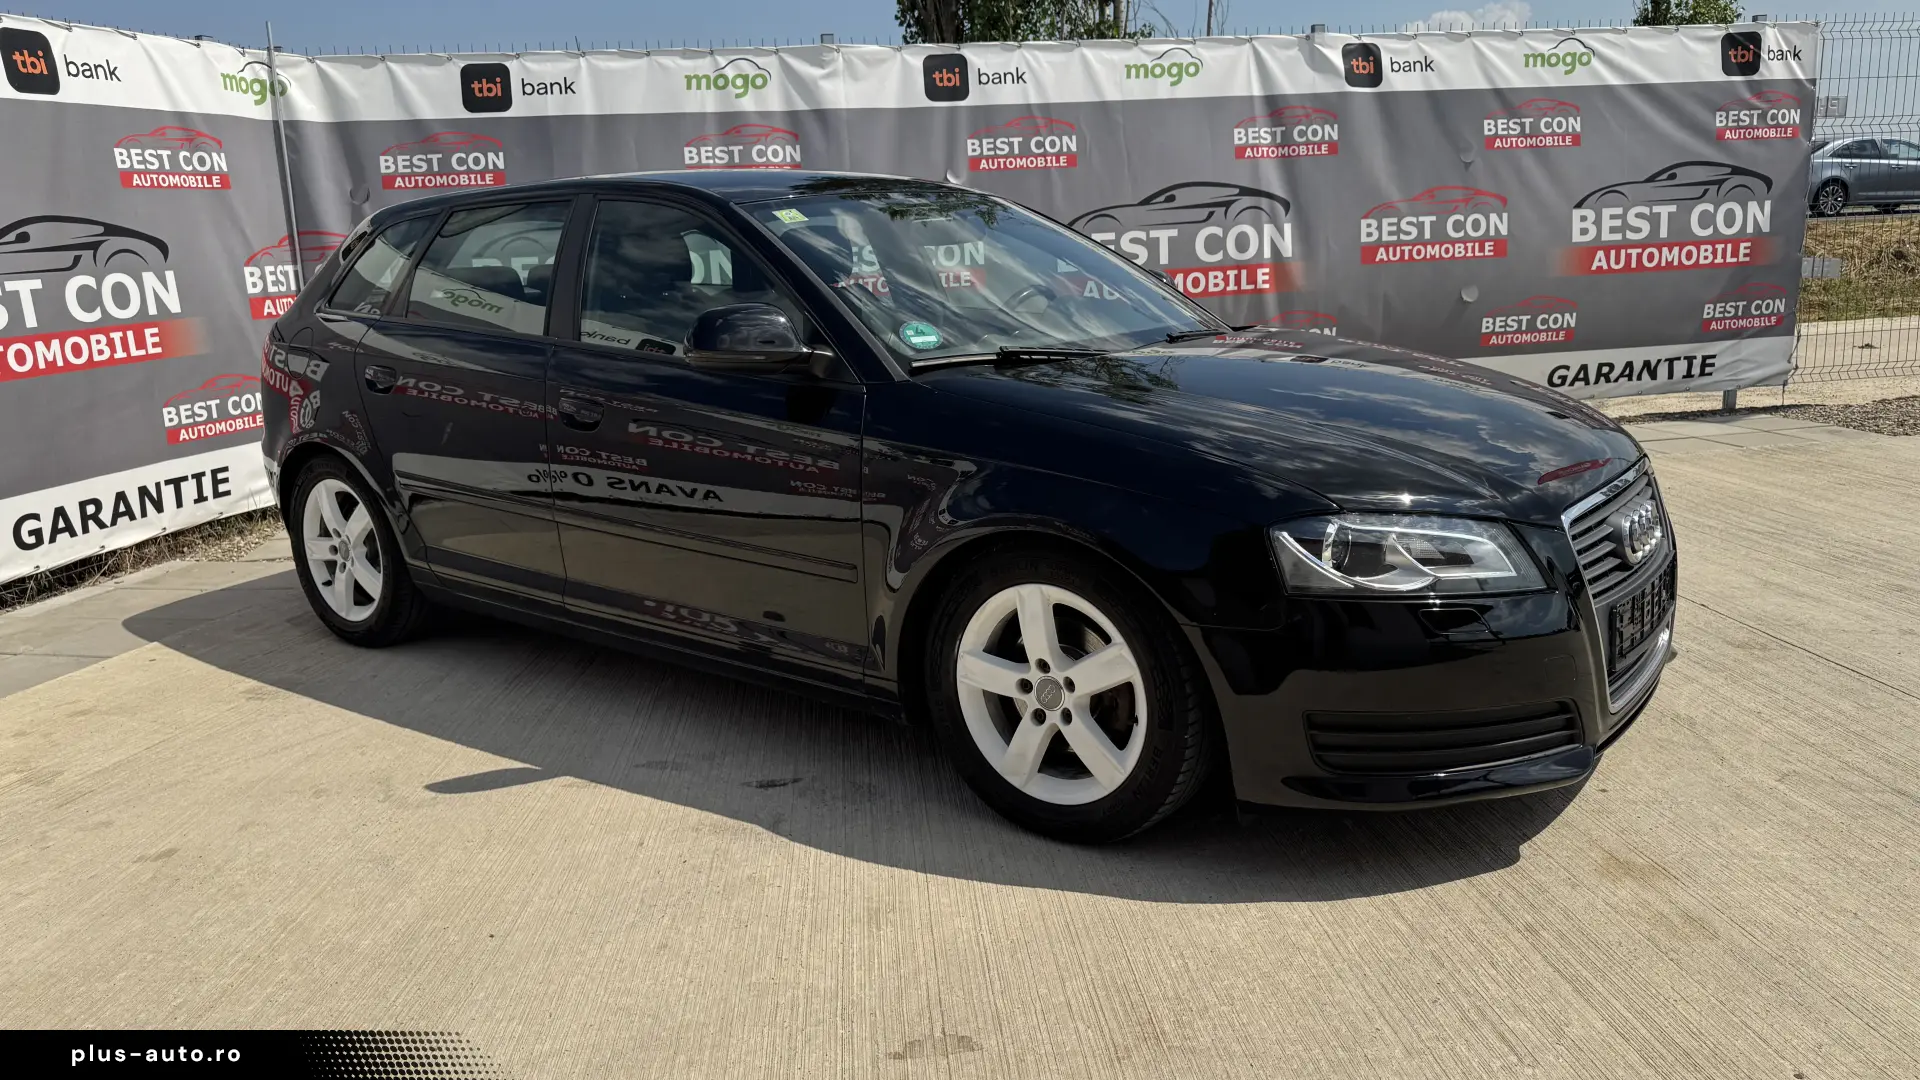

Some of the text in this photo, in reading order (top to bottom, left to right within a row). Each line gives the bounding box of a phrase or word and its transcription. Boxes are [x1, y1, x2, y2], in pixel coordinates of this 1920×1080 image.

[1351, 56, 1435, 74] tbi bank
[1523, 49, 1593, 75] mogo
[1729, 45, 1802, 63] tbi bank
[12, 49, 121, 82] tbi bank
[1124, 61, 1201, 87] mogo
[471, 77, 576, 98] tbi bank
[684, 73, 768, 99] mogo
[932, 67, 1027, 87] tbi bank
[221, 71, 288, 106] mogo
[1483, 116, 1581, 135] BEST CON
[1715, 108, 1800, 127] BEST CON
[1233, 124, 1339, 145] BEST CON
[1494, 136, 1573, 148] AUTOMOBILE
[1724, 127, 1793, 140] AUTOMOBILE
[683, 144, 802, 165] BEST CON
[966, 134, 1078, 156] BEST CON
[1244, 144, 1328, 158] AUTOMOBILE
[113, 147, 228, 172] BEST CON
[379, 151, 505, 174] BEST CON
[979, 156, 1067, 170] AUTOMOBILE
[132, 173, 222, 188] AUTOMOBILE
[394, 173, 494, 188] AUTOMOBILE
[1361, 212, 1509, 243] BEST CON
[1572, 200, 1772, 243] BEST CON
[1091, 226, 1294, 277] EST CON
[1375, 241, 1495, 263] AUTOMOBILE
[1590, 241, 1752, 272] AUTOMOBILE
[243, 265, 299, 295] BEST
[65, 270, 182, 323] CON
[1703, 298, 1786, 319] BEST CON
[1481, 312, 1577, 334] BEST CON
[1709, 316, 1777, 331] AUTOMOBILE
[1489, 331, 1566, 346] AUTOMOBILE
[0, 327, 163, 374] OMOBILE
[1546, 353, 1718, 389] GARANTIE
[162, 399, 220, 428] BEST
[178, 415, 264, 442] AUTOMOBILE
[12, 465, 232, 551] GARANTIE
